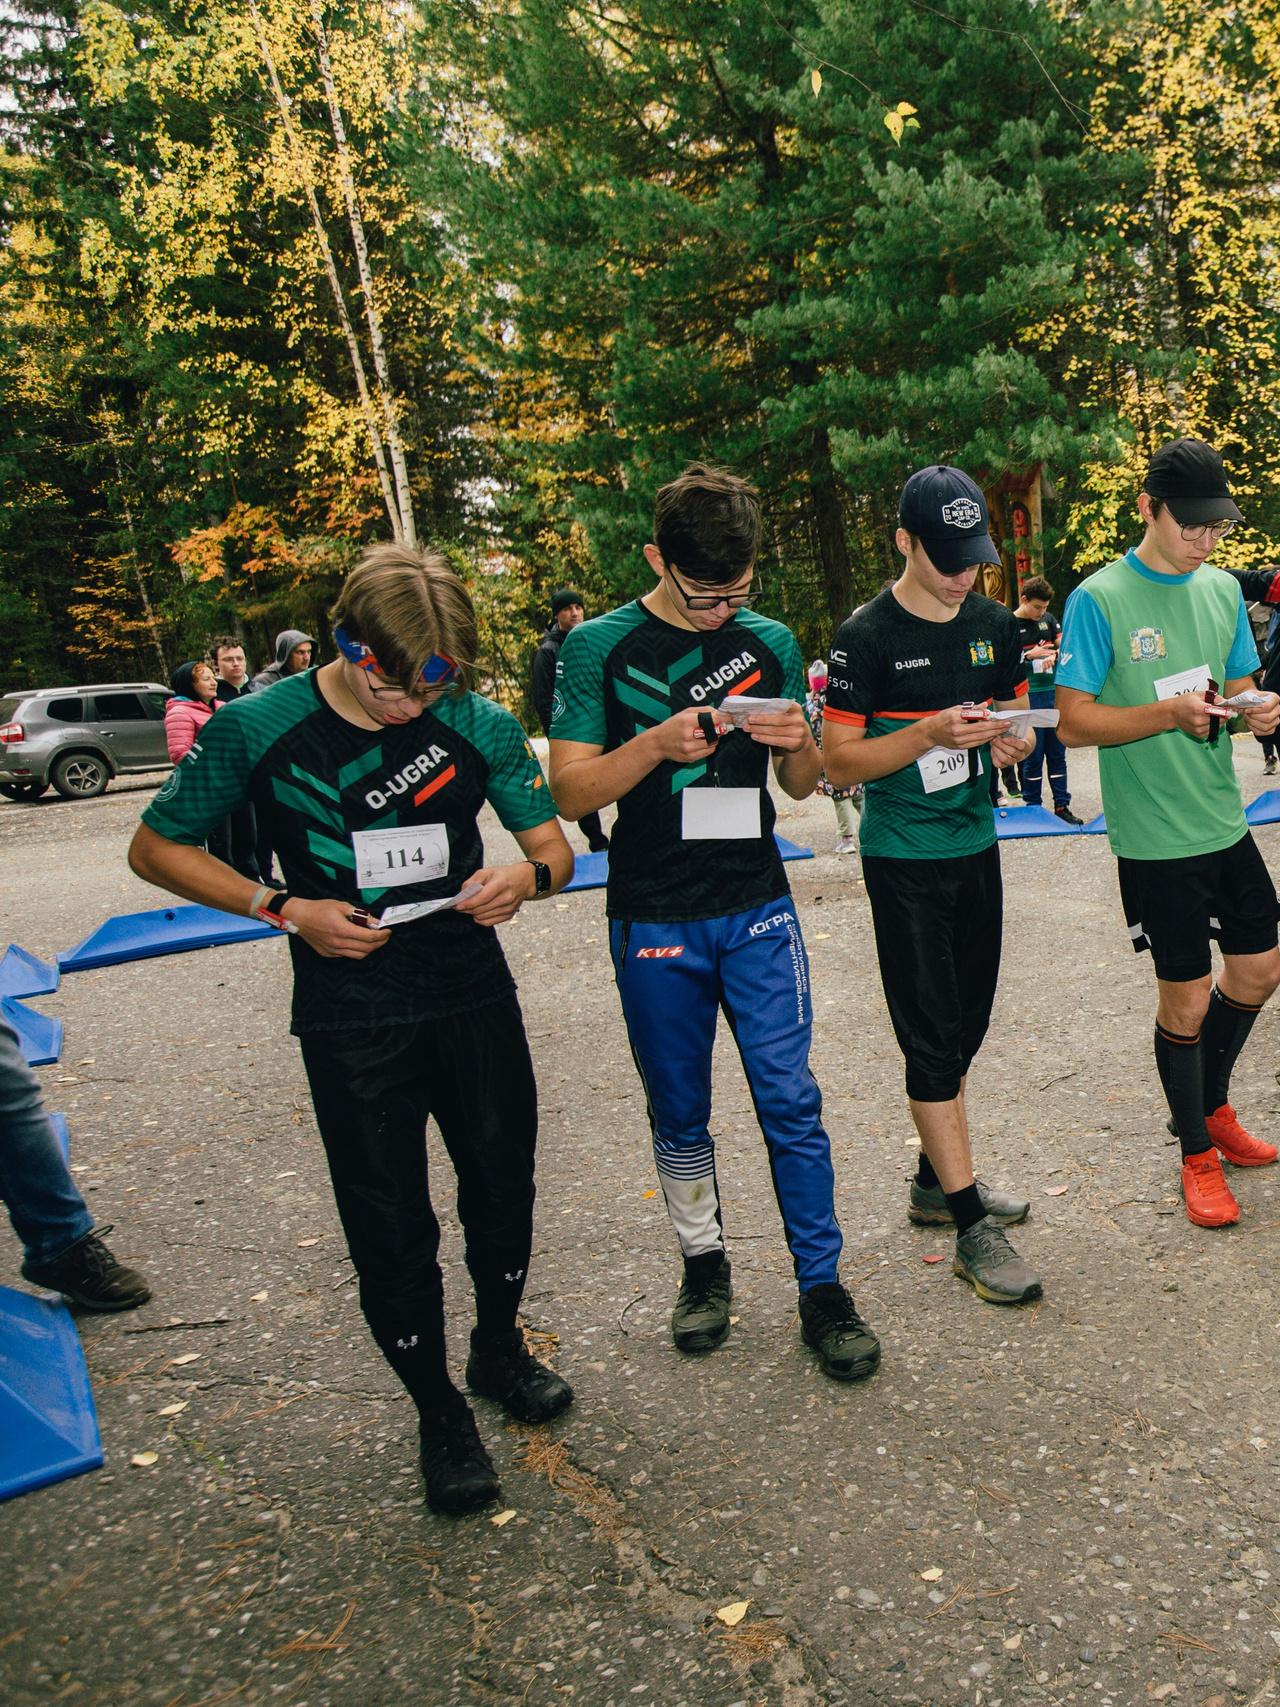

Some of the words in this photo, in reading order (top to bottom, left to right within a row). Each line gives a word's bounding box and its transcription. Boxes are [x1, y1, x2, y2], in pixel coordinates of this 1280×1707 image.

[689, 650, 758, 702] O-UGRA
[895, 657, 931, 670] O-UGRA
[936, 753, 965, 775] 209
[365, 744, 449, 810] O-UGRA
[384, 846, 425, 869] 114
[749, 912, 794, 937] ЮГРА
[636, 946, 684, 958] KV+
[791, 923, 808, 993] СПОРТИВНОЕ
[786, 924, 805, 1025] ОРИЕНТИРОВАНИЕ
